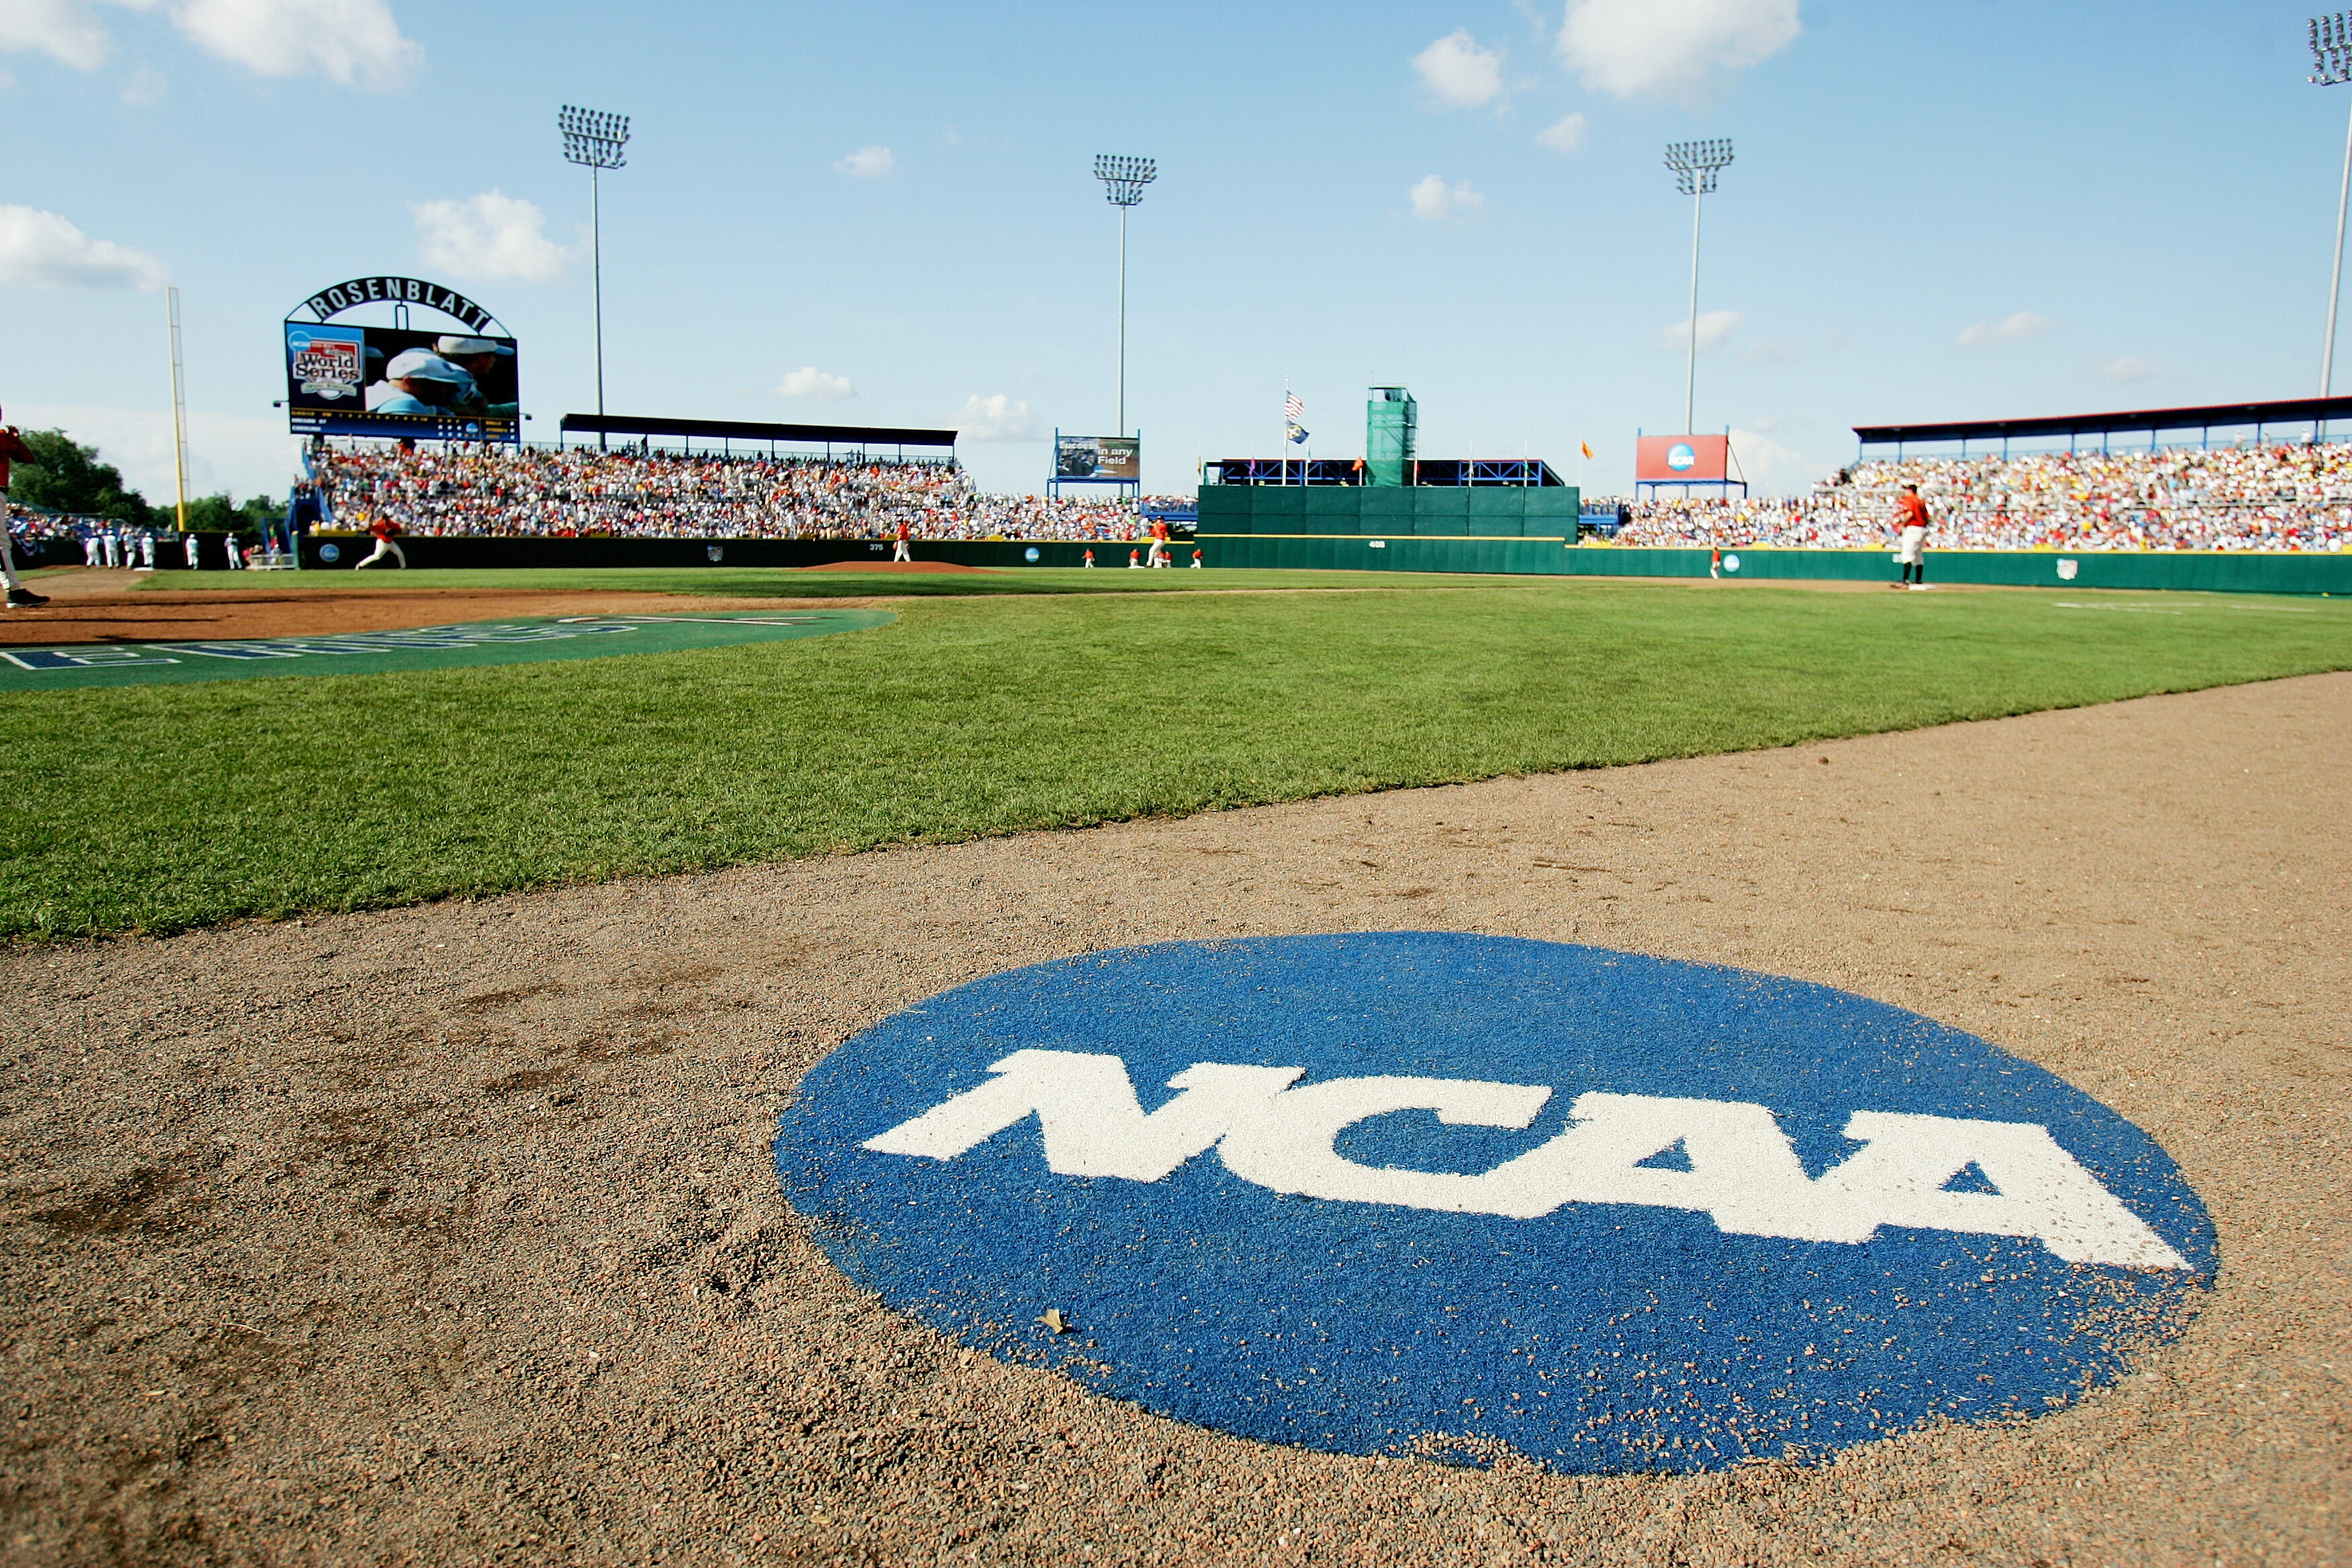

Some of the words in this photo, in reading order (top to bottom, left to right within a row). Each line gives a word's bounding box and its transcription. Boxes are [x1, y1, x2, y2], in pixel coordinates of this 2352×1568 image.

[310, 279, 489, 329] ROSENBLATT
[301, 353, 354, 369] World
[296, 363, 360, 380] Series
[1097, 447, 1109, 455] in
[1112, 449, 1133, 457] any
[1097, 456, 1126, 464] Field
[869, 543, 884, 551] 375
[862, 1048, 2193, 1271] NCAA
